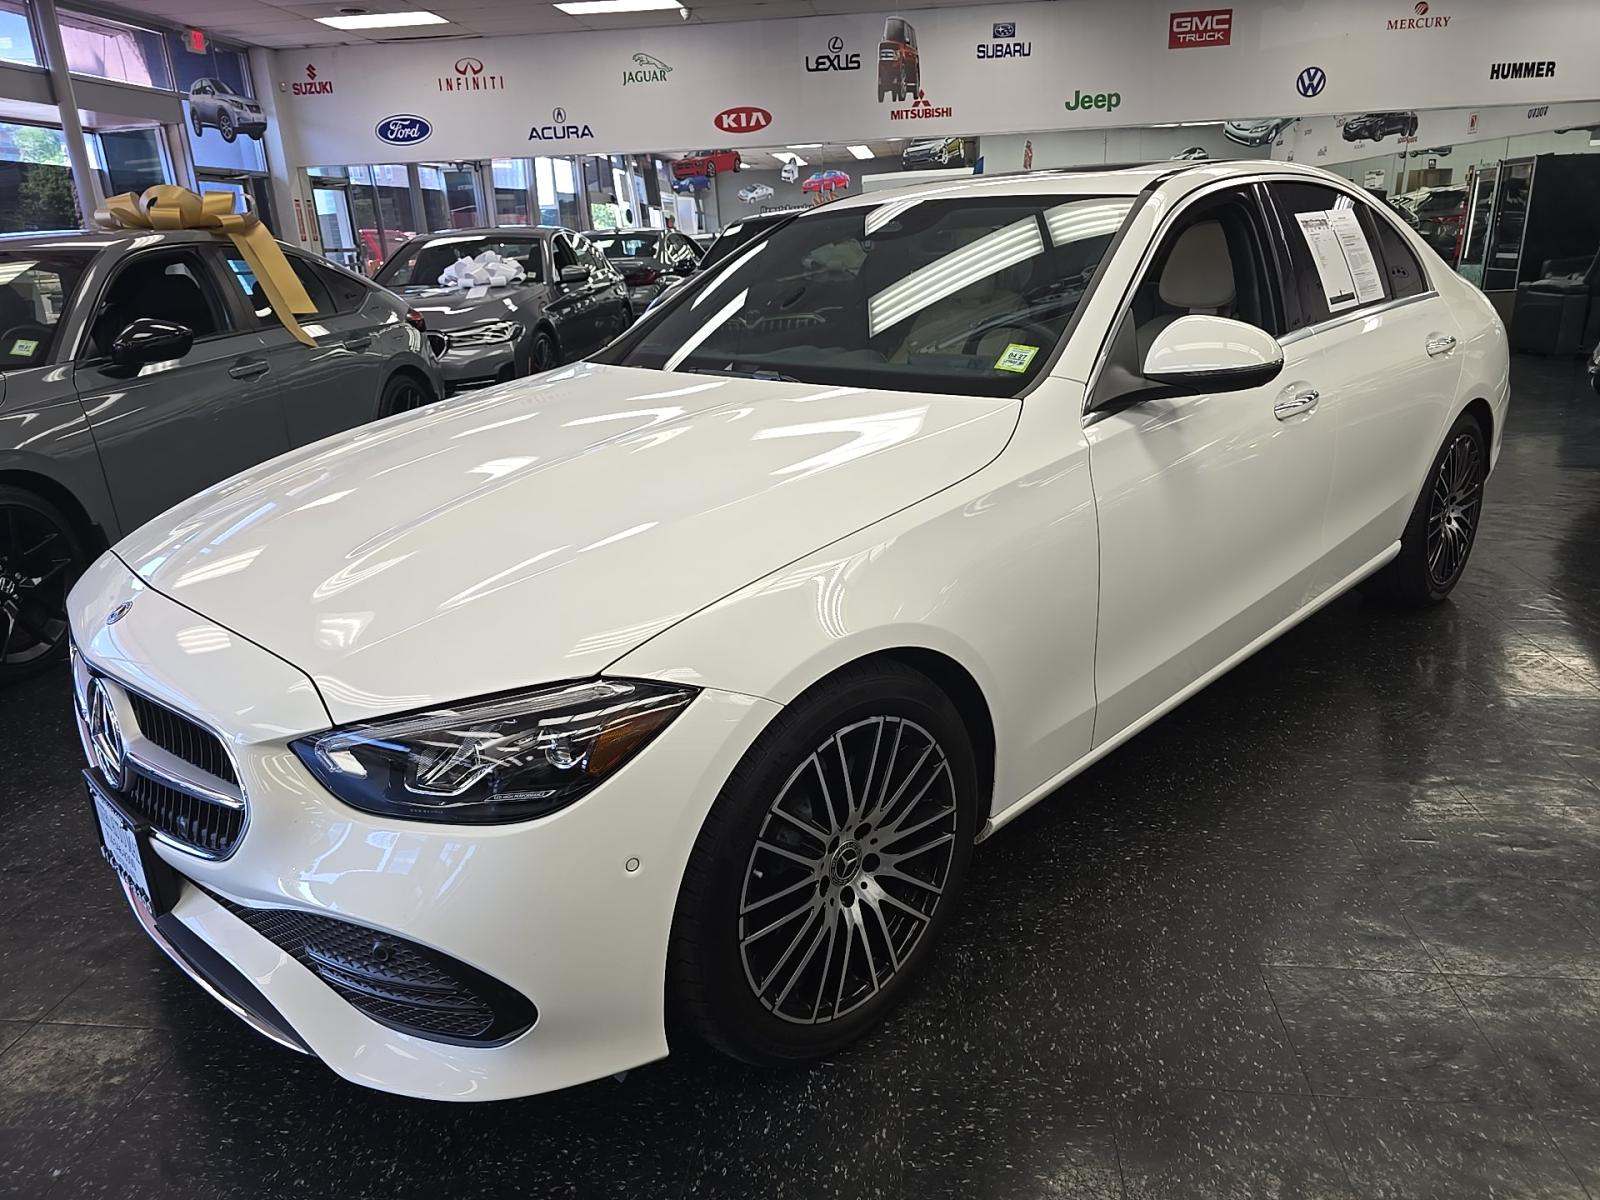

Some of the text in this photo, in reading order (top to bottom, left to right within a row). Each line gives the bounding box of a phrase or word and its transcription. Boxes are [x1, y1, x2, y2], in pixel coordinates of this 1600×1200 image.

[1173, 14, 1229, 32] GMC
[1386, 16, 1451, 30] MERCURY
[1177, 32, 1224, 43] TRUCK
[977, 42, 1031, 59] SUBARU
[806, 54, 861, 72] LEXUS
[1490, 61, 1556, 80] HUMMER
[438, 76, 504, 91] INFINITI
[622, 70, 667, 86] JAGUAR
[292, 81, 333, 96] SUZUKI
[1064, 90, 1122, 112] Jeep
[721, 111, 767, 129] KIA
[890, 107, 952, 121] MITSUBISHI
[387, 119, 421, 139] Ford
[528, 124, 595, 141] ACURA
